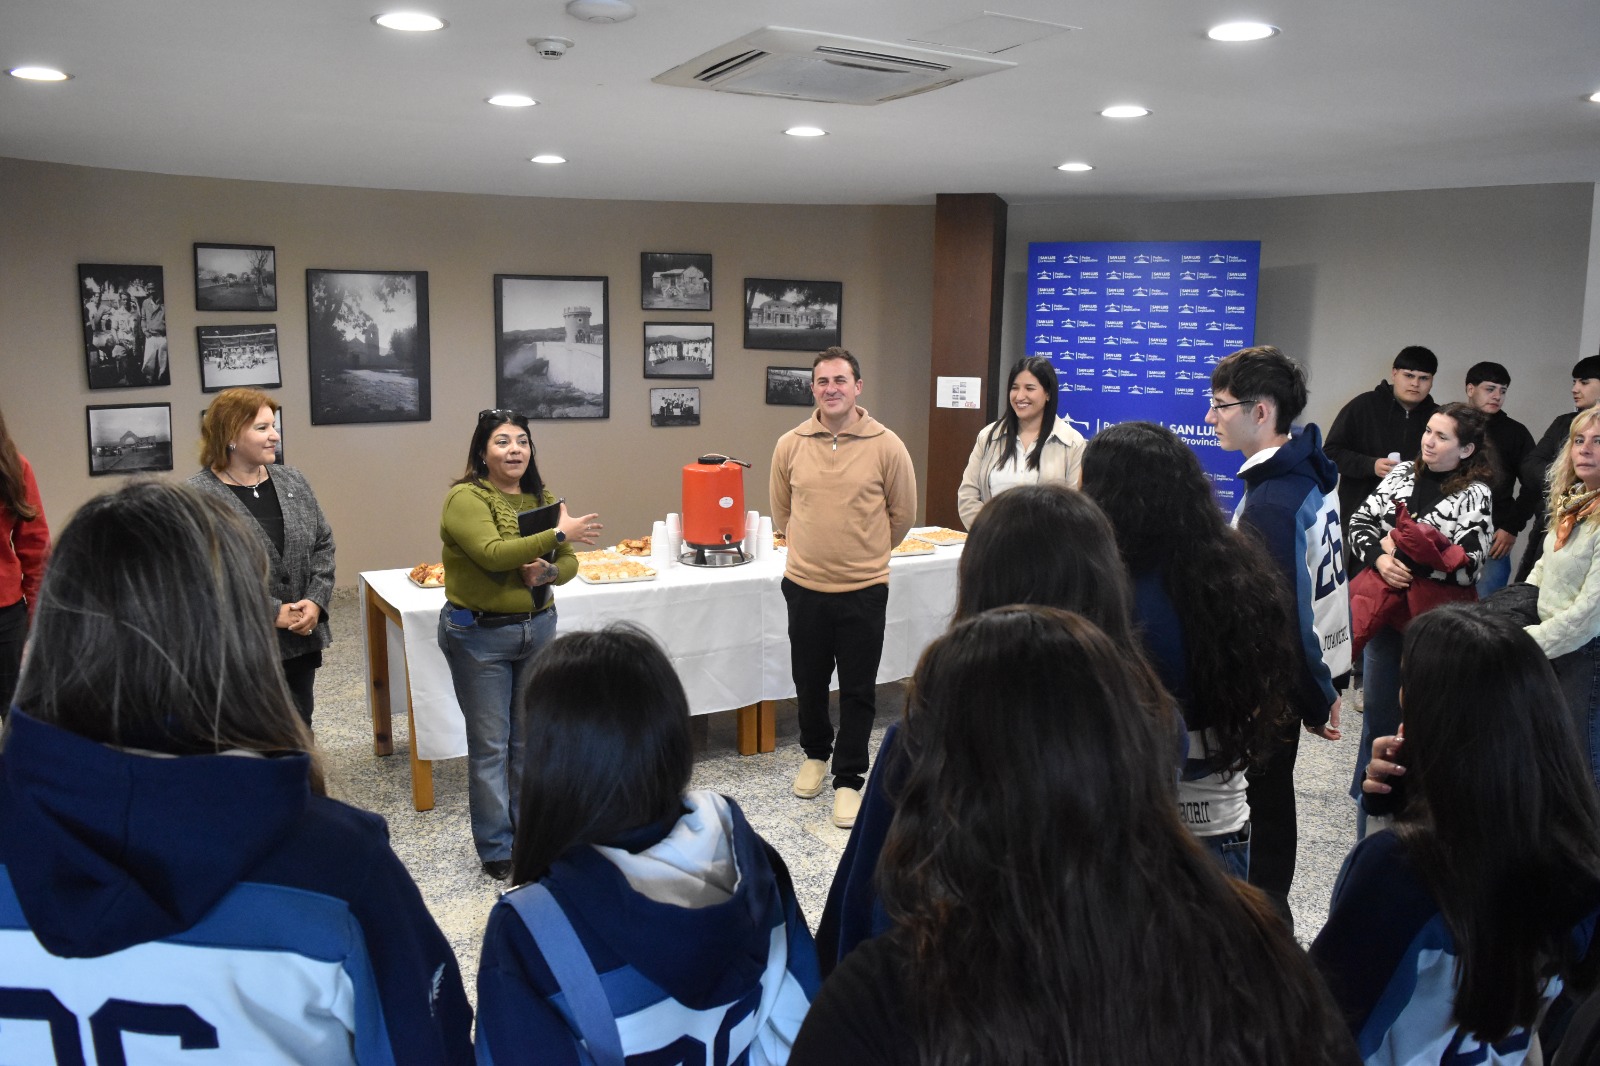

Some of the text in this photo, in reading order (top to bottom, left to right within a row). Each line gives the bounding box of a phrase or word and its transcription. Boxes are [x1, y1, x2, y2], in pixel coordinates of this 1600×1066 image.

[1169, 424, 1219, 436] SAN LUI
[1181, 437, 1222, 447] Provincia
[1315, 509, 1346, 602] 26
